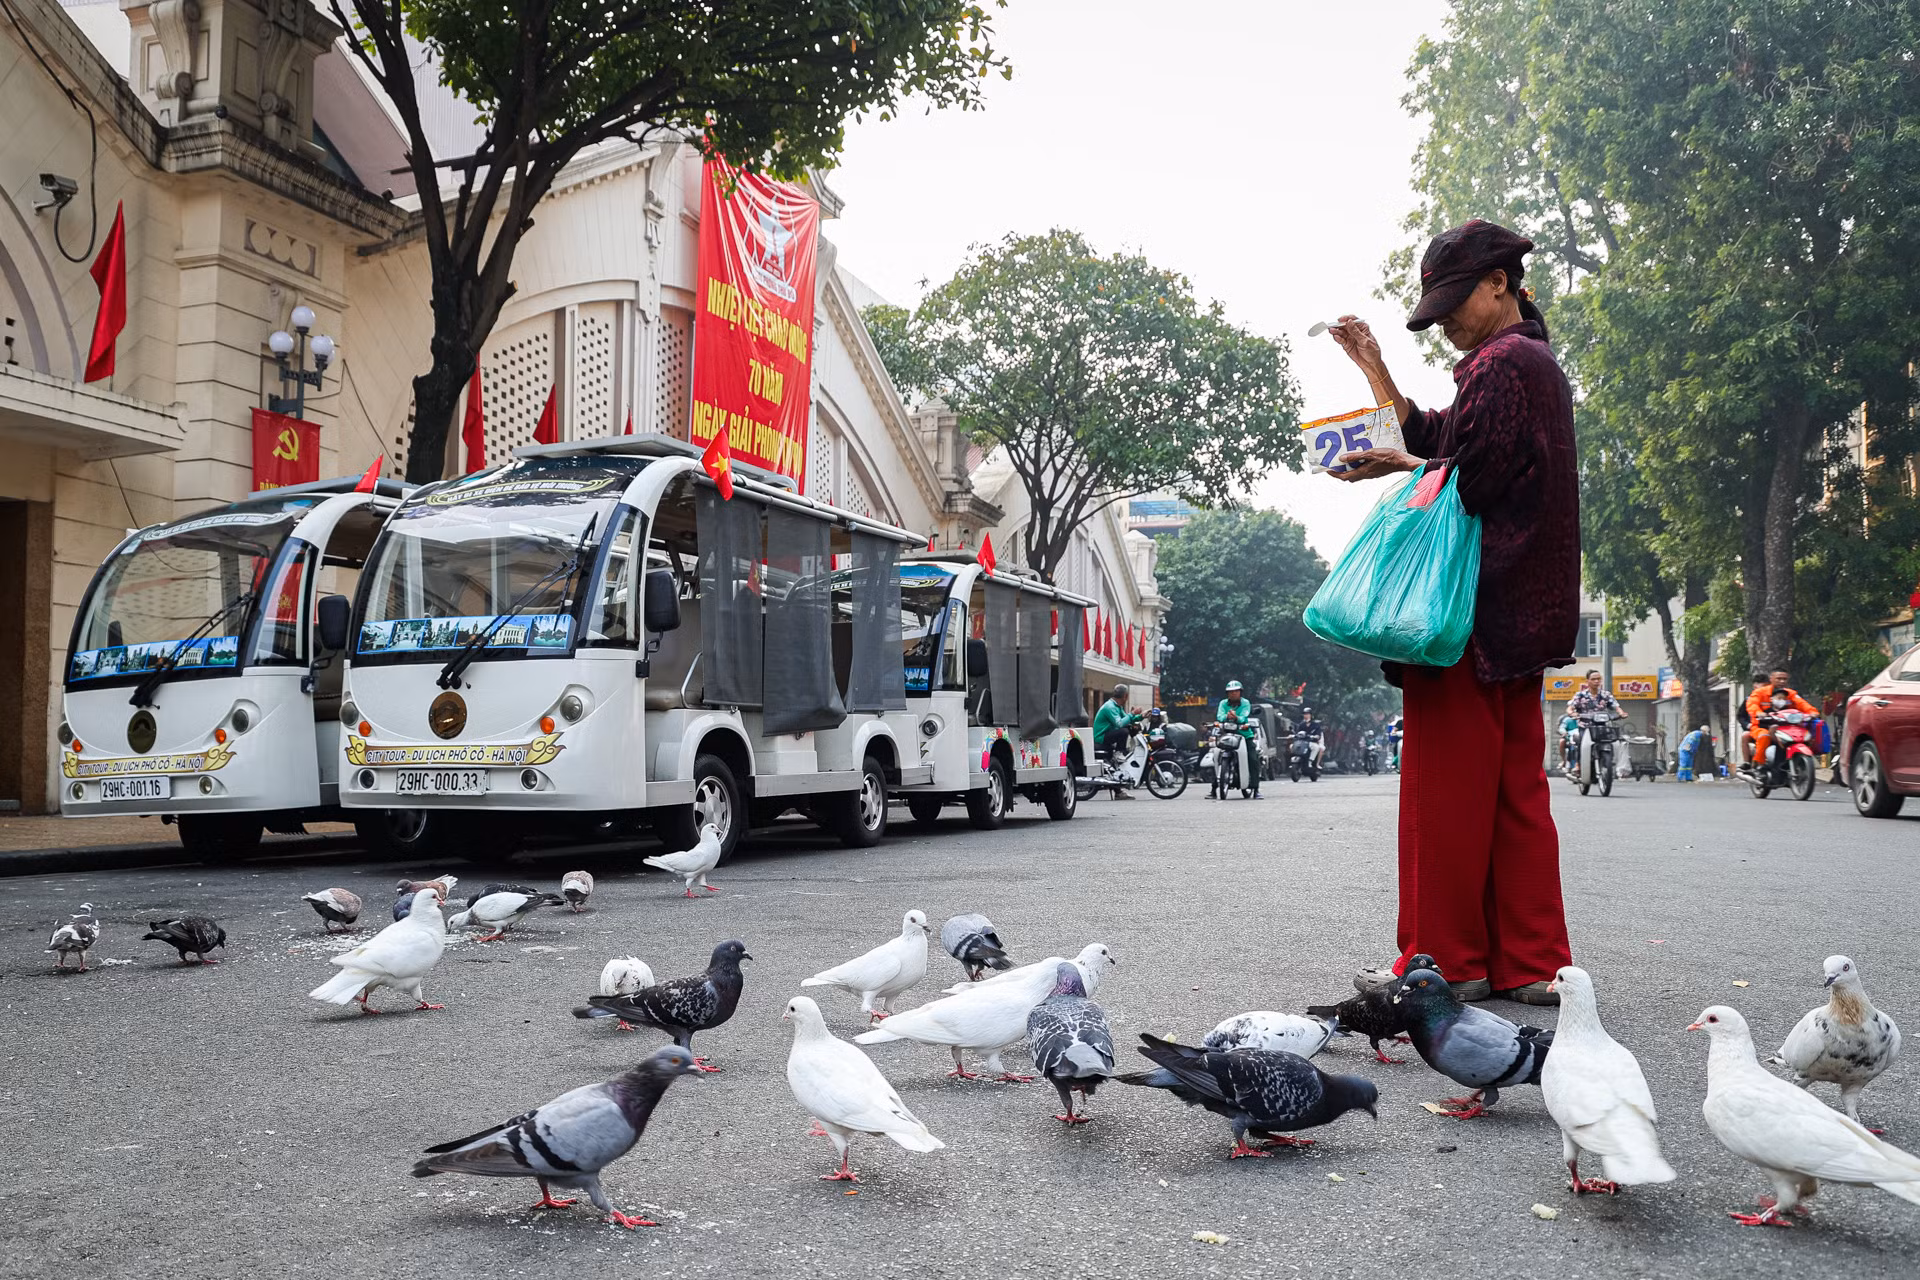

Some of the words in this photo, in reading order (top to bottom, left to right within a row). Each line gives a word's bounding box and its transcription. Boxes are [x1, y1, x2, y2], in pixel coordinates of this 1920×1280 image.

[748, 358, 762, 395] 70
[762, 361, 783, 407] NĂM
[693, 398, 728, 441] NGÀY
[729, 405, 753, 454] GIẢI
[1315, 423, 1373, 473] 25
[78, 764, 91, 775] CITY
[91, 763, 109, 774] TOUR
[112, 763, 122, 772] DU
[123, 761, 139, 775] LỊCH
[175, 755, 187, 769] HÀ
[366, 750, 384, 763] CITY
[385, 750, 407, 761] TOUR
[412, 750, 424, 761] DU
[426, 750, 447, 764] LỊCH
[491, 746, 505, 762] HÀ
[507, 747, 527, 765] NỘI
[399, 772, 478, 791] 29HC-000.33
